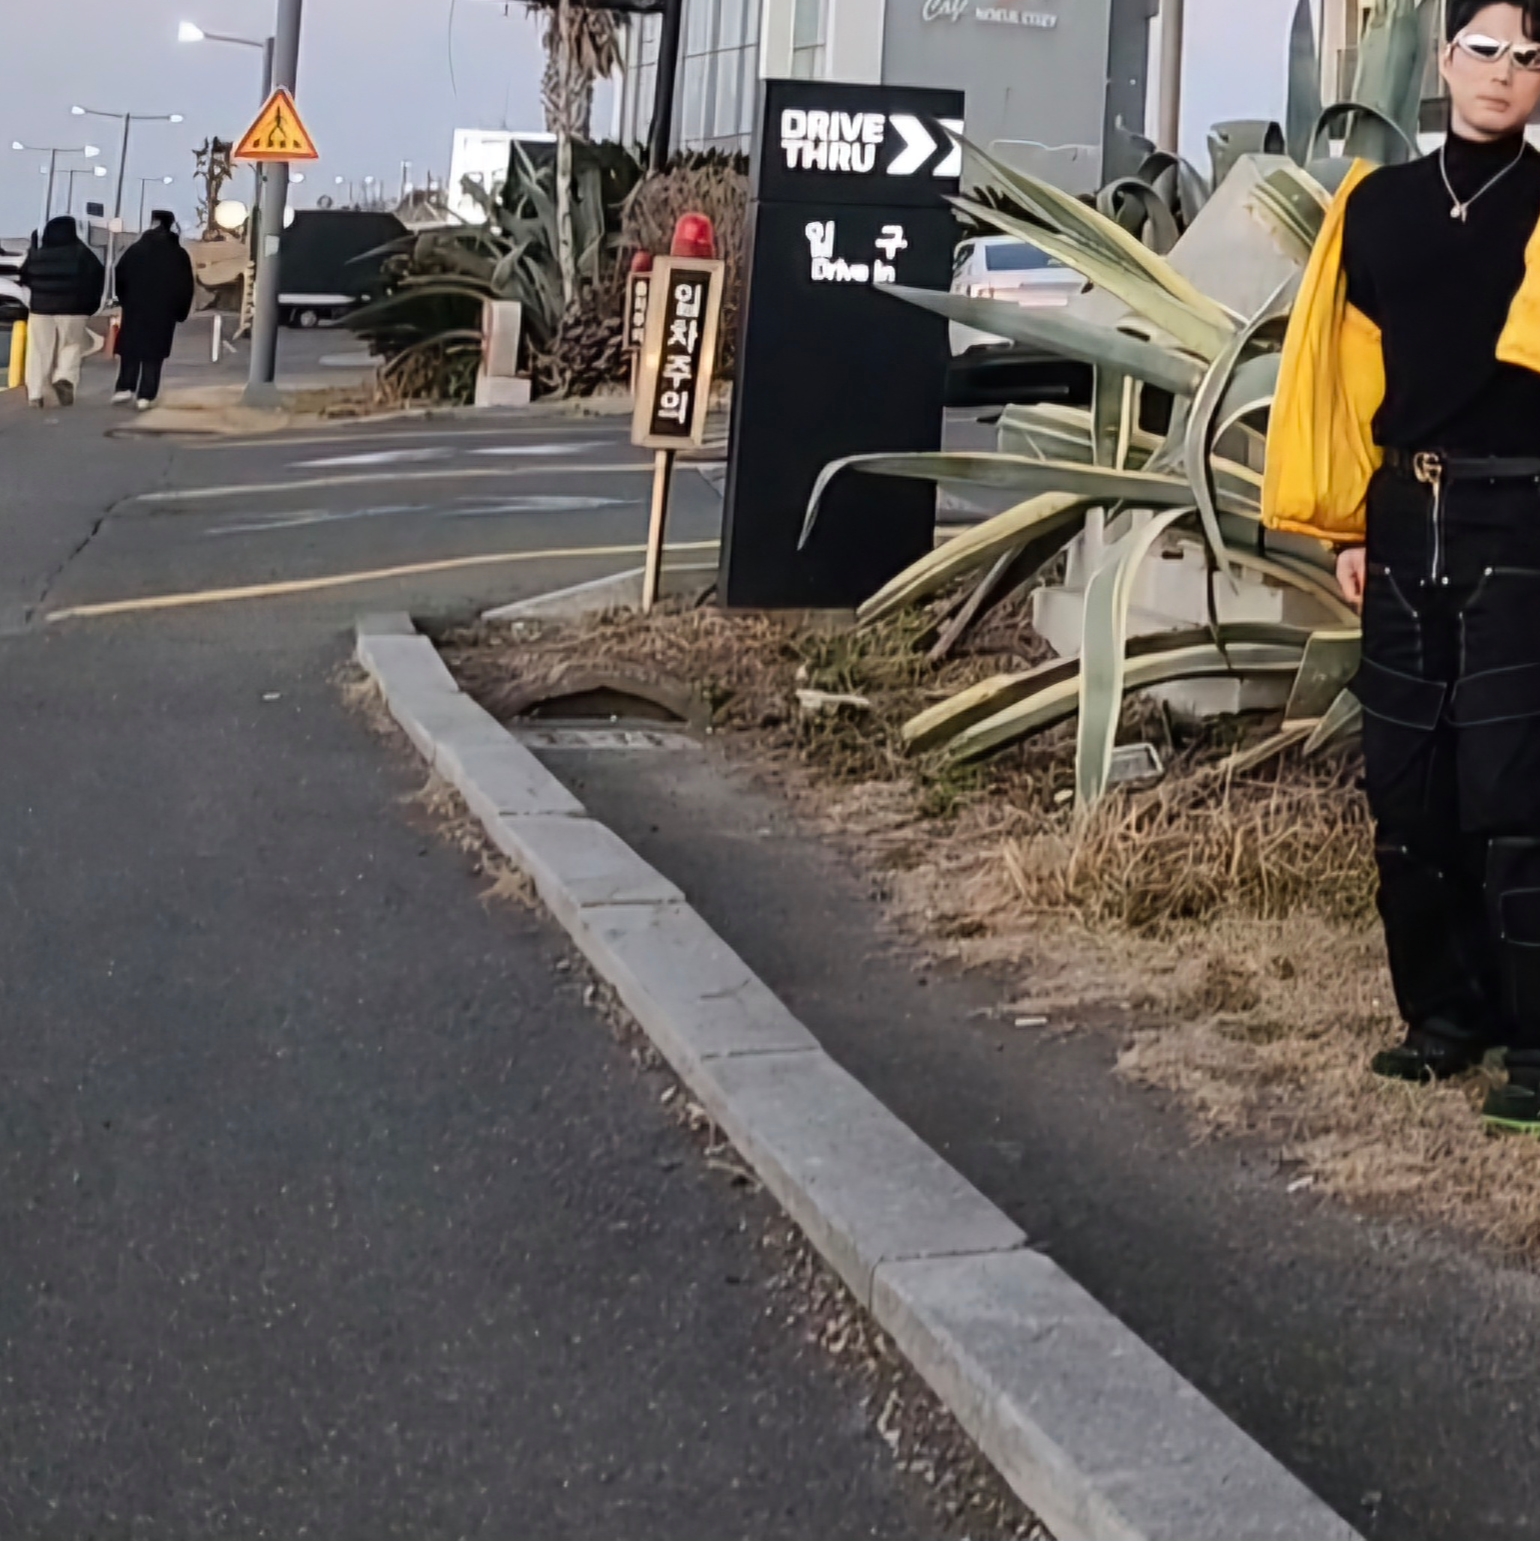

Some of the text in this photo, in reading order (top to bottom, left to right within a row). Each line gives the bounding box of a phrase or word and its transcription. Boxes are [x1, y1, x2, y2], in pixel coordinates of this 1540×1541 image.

[781, 109, 886, 144] DRIVE
[781, 139, 876, 173] THRU
[811, 257, 869, 282] Drive
